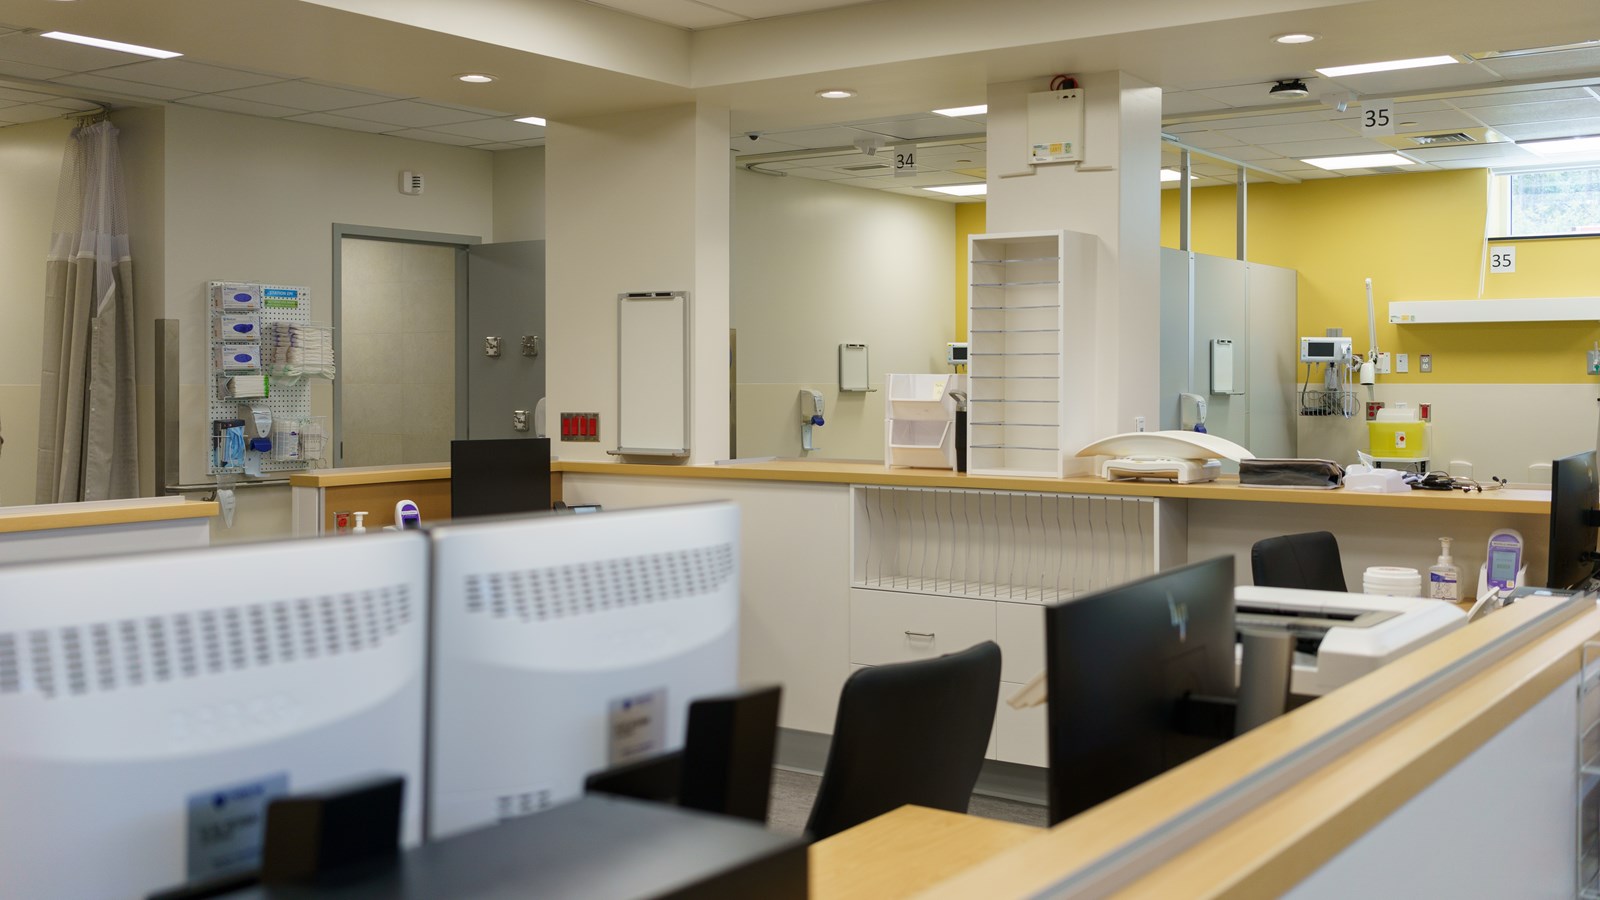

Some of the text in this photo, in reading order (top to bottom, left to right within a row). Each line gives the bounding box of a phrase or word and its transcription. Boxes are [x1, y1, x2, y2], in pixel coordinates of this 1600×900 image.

[1364, 108, 1390, 128] 35
[896, 152, 915, 170] 34
[1492, 254, 1512, 268] 35
